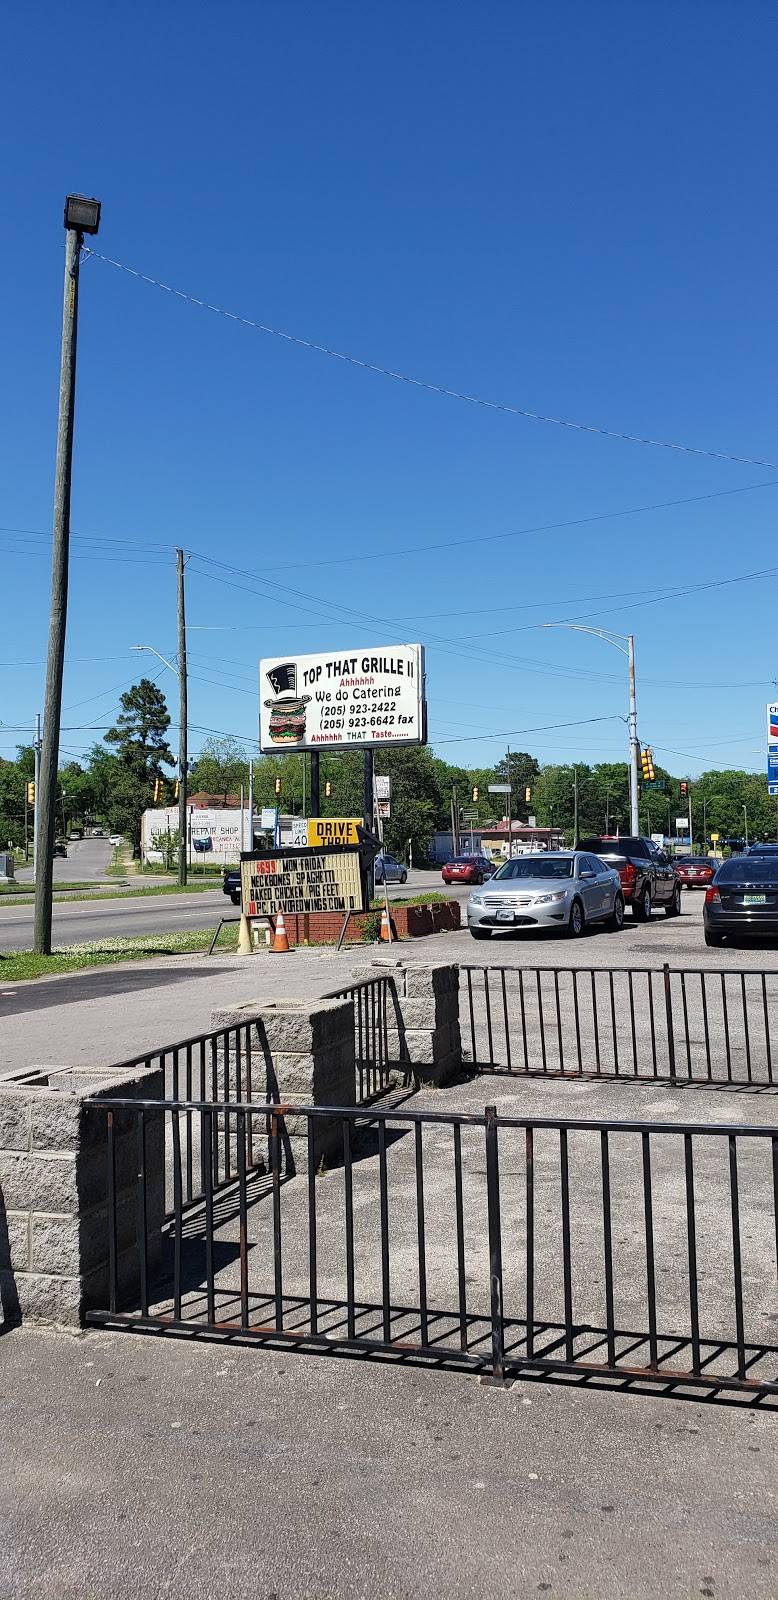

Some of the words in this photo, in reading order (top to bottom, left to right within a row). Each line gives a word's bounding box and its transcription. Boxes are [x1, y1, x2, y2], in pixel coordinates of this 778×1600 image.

[303, 665, 322, 687] TOP
[326, 659, 357, 678] THAT
[362, 658, 404, 675] GRILLE
[316, 691, 331, 702] We
[336, 690, 348, 700] do
[353, 686, 401, 699] Catering
[321, 705, 345, 717] (205)
[350, 702, 396, 714] 923-2422
[320, 719, 345, 730] (205)
[349, 715, 394, 728] 923-6642
[398, 714, 414, 724] fax
[347, 731, 366, 740] THAT
[191, 827, 216, 835] REPAIR
[317, 823, 352, 836] DRIVE
[294, 836, 307, 846] 40
[251, 873, 290, 887] NECKBONES
[296, 870, 335, 884] SPAGHETTI
[250, 888, 272, 901] BAKED
[274, 886, 303, 899] CHICKEN
[309, 885, 320, 897] PIG
[323, 883, 339, 896] FEET
